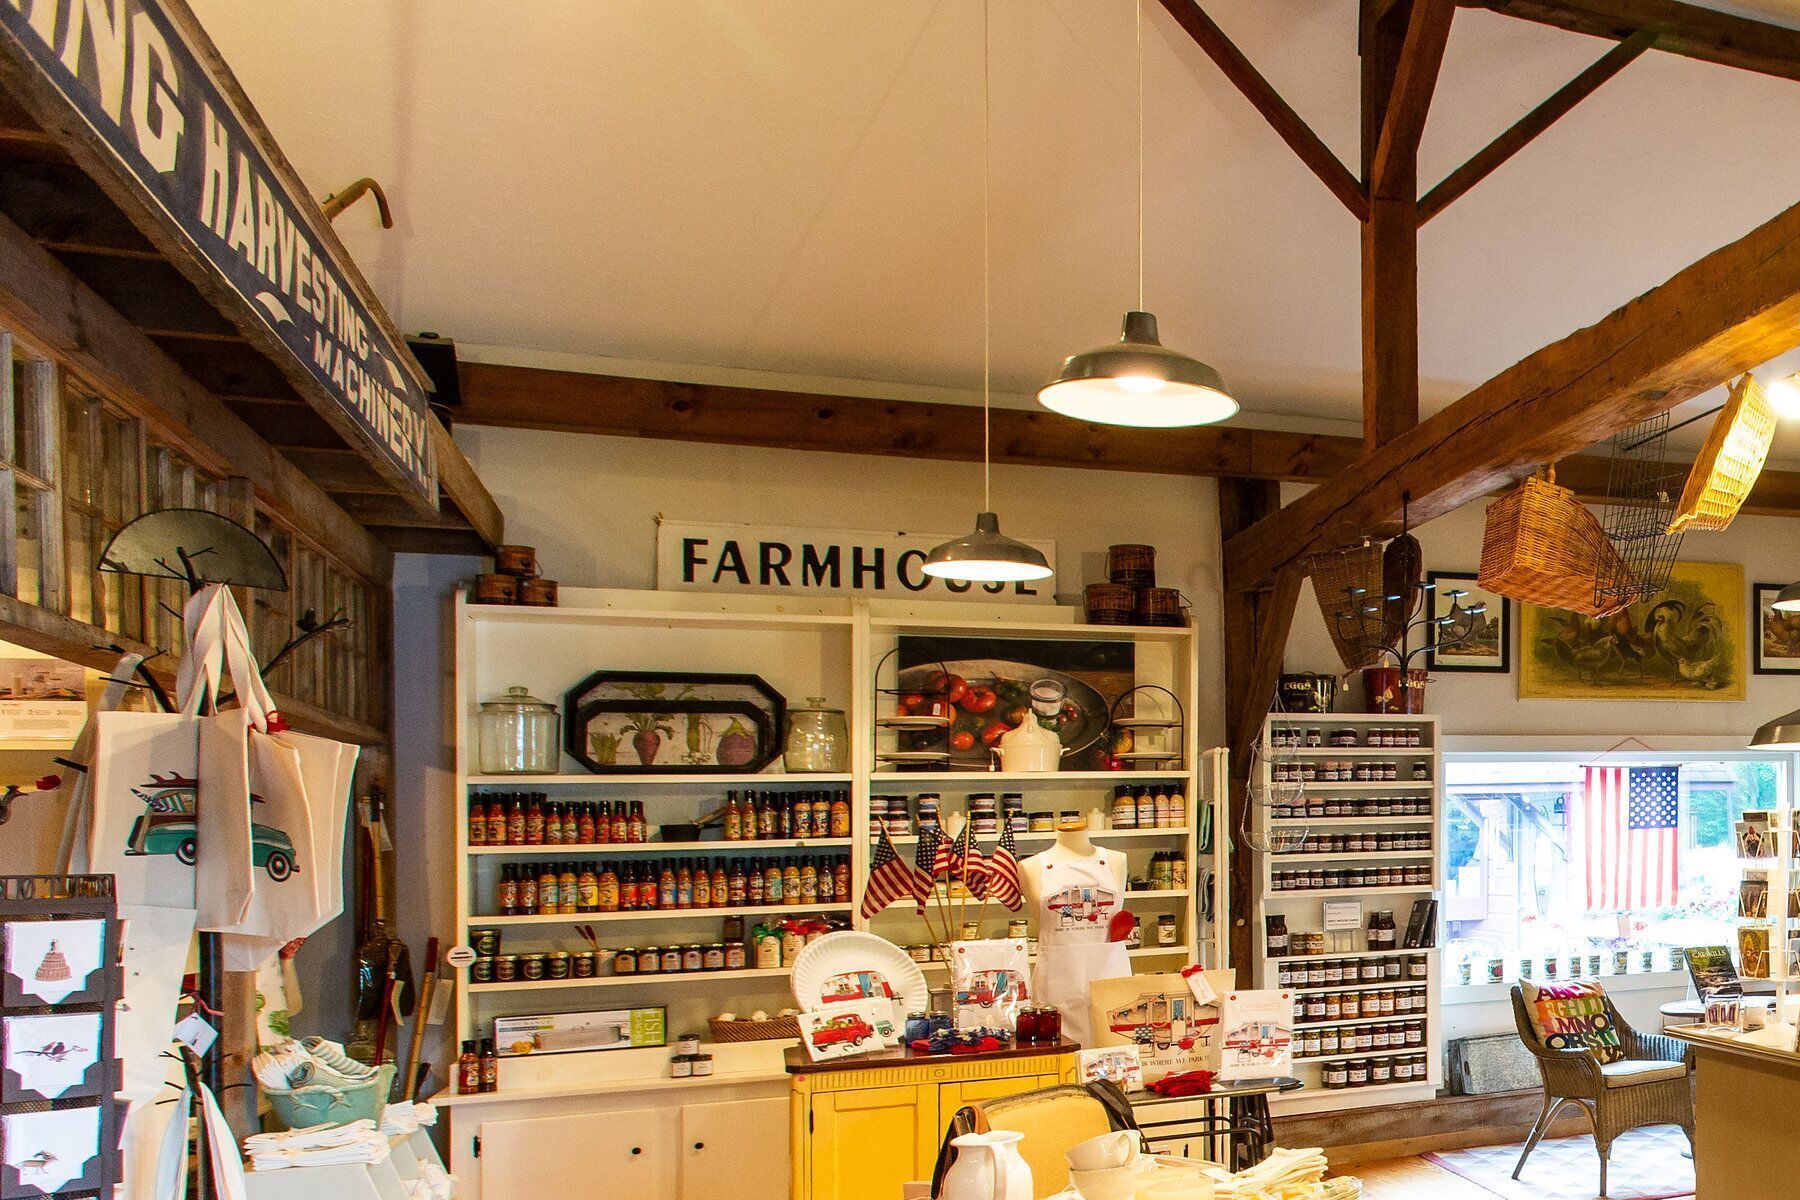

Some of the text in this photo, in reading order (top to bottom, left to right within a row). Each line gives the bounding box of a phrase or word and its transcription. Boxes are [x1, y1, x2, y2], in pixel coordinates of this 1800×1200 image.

[201, 102, 370, 360] HARVESTING
[682, 537, 1038, 596] FARMHO
[1283, 680, 1312, 691] EGGS
[645, 1008, 662, 1045] FISH
[1149, 1058, 1173, 1067] WHERE
[1174, 1057, 1188, 1065] WE
[1188, 1056, 1204, 1064] PARK
